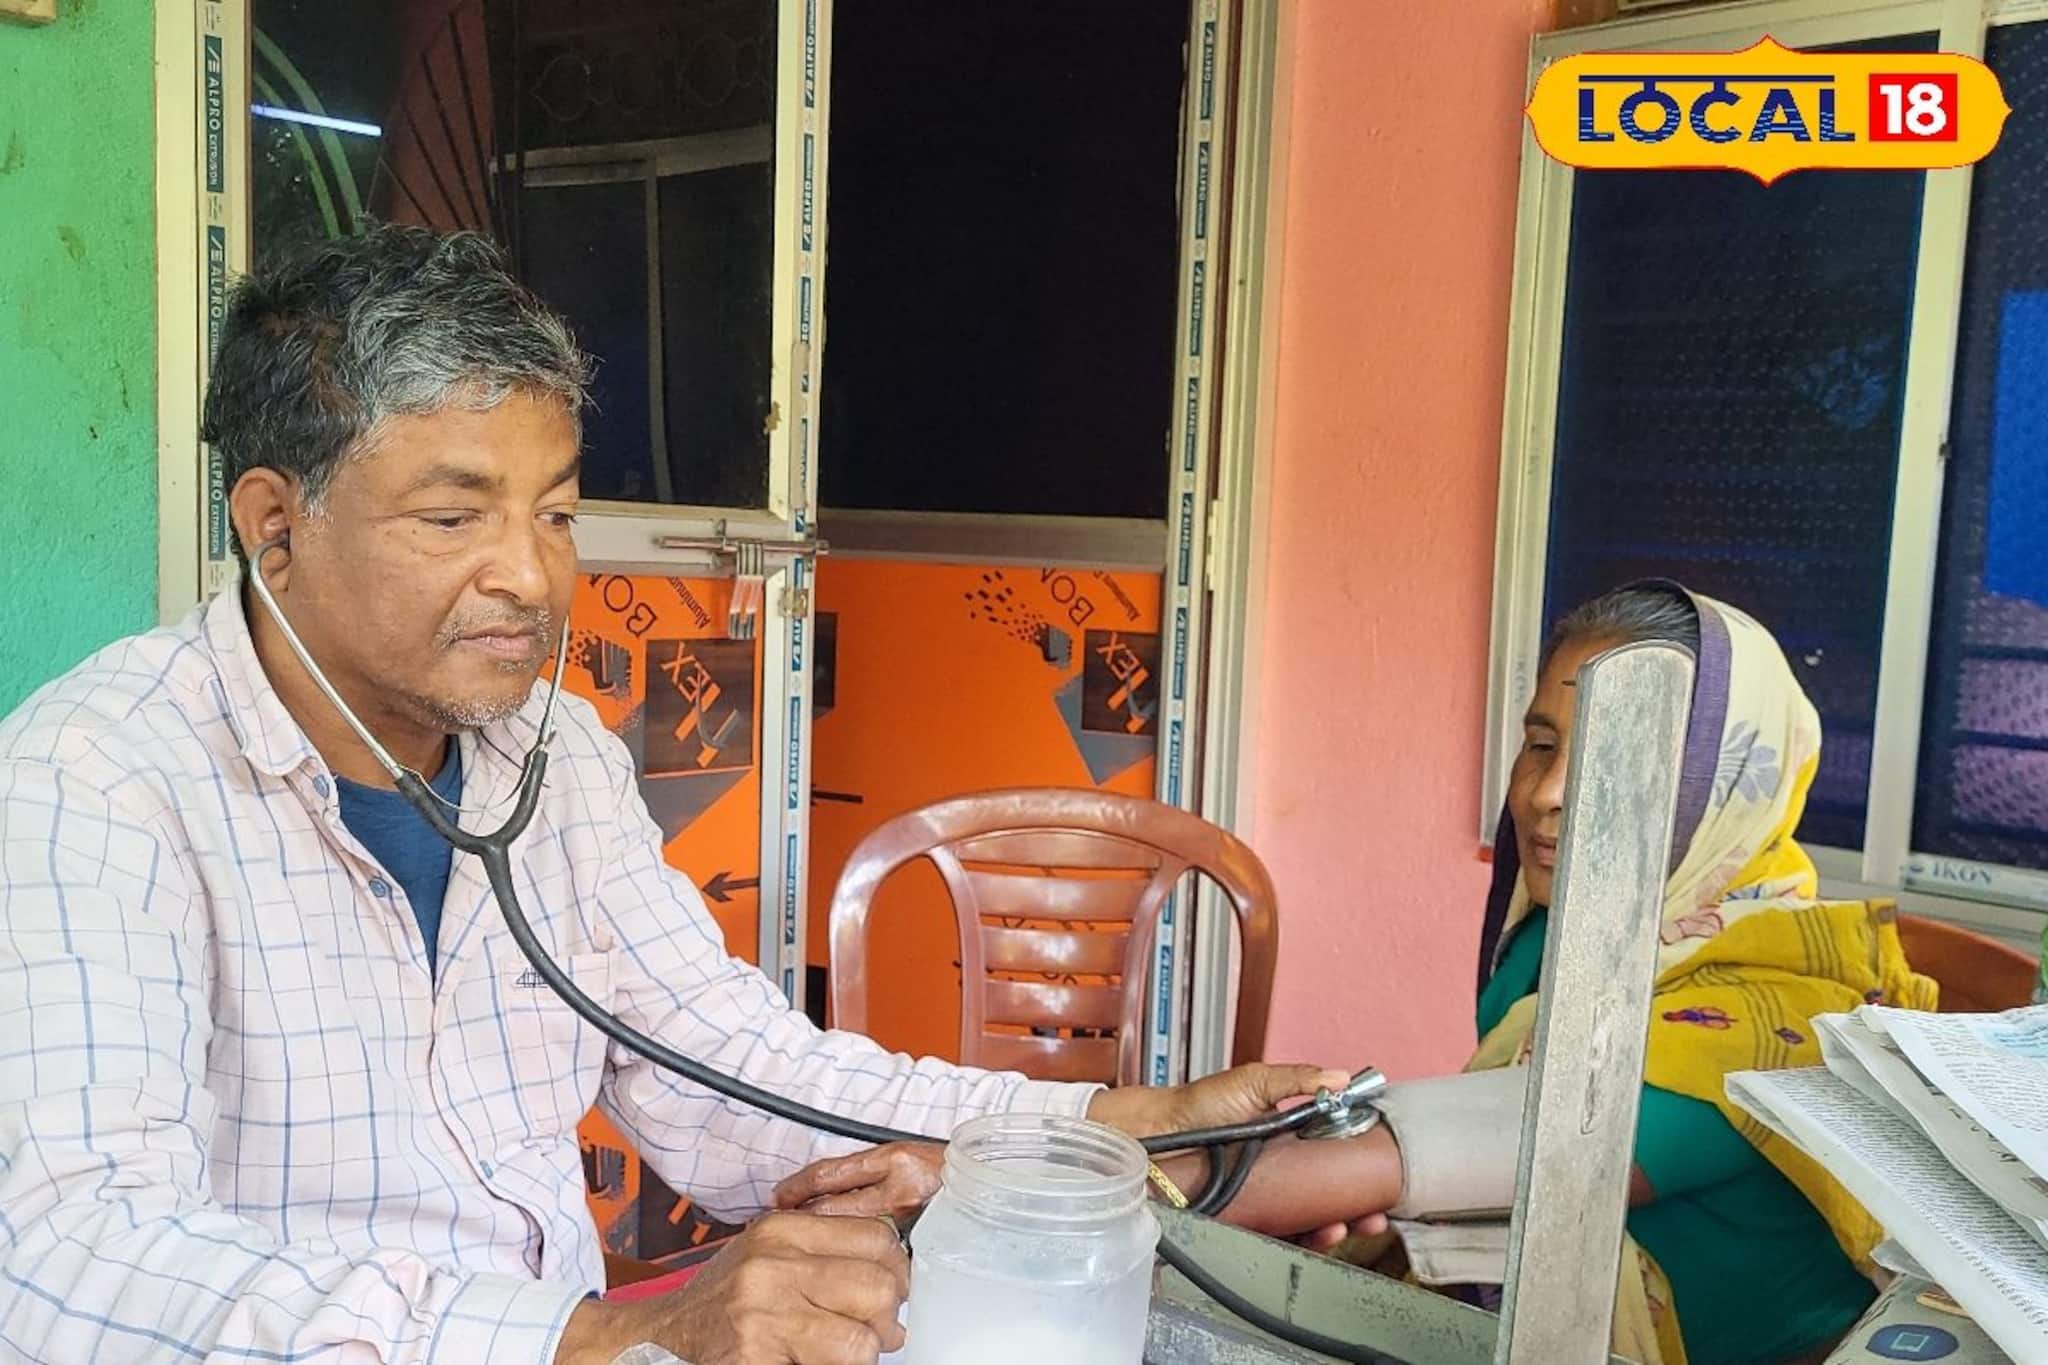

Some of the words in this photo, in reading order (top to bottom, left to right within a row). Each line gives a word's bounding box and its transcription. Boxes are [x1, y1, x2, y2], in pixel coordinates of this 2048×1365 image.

[806, 36, 814, 80] ALPRO
[208, 77, 221, 130] ALPRO
[803, 180, 812, 222] ALPRO
[210, 266, 223, 318] ALPRO
[211, 447, 224, 501] ALPRO
